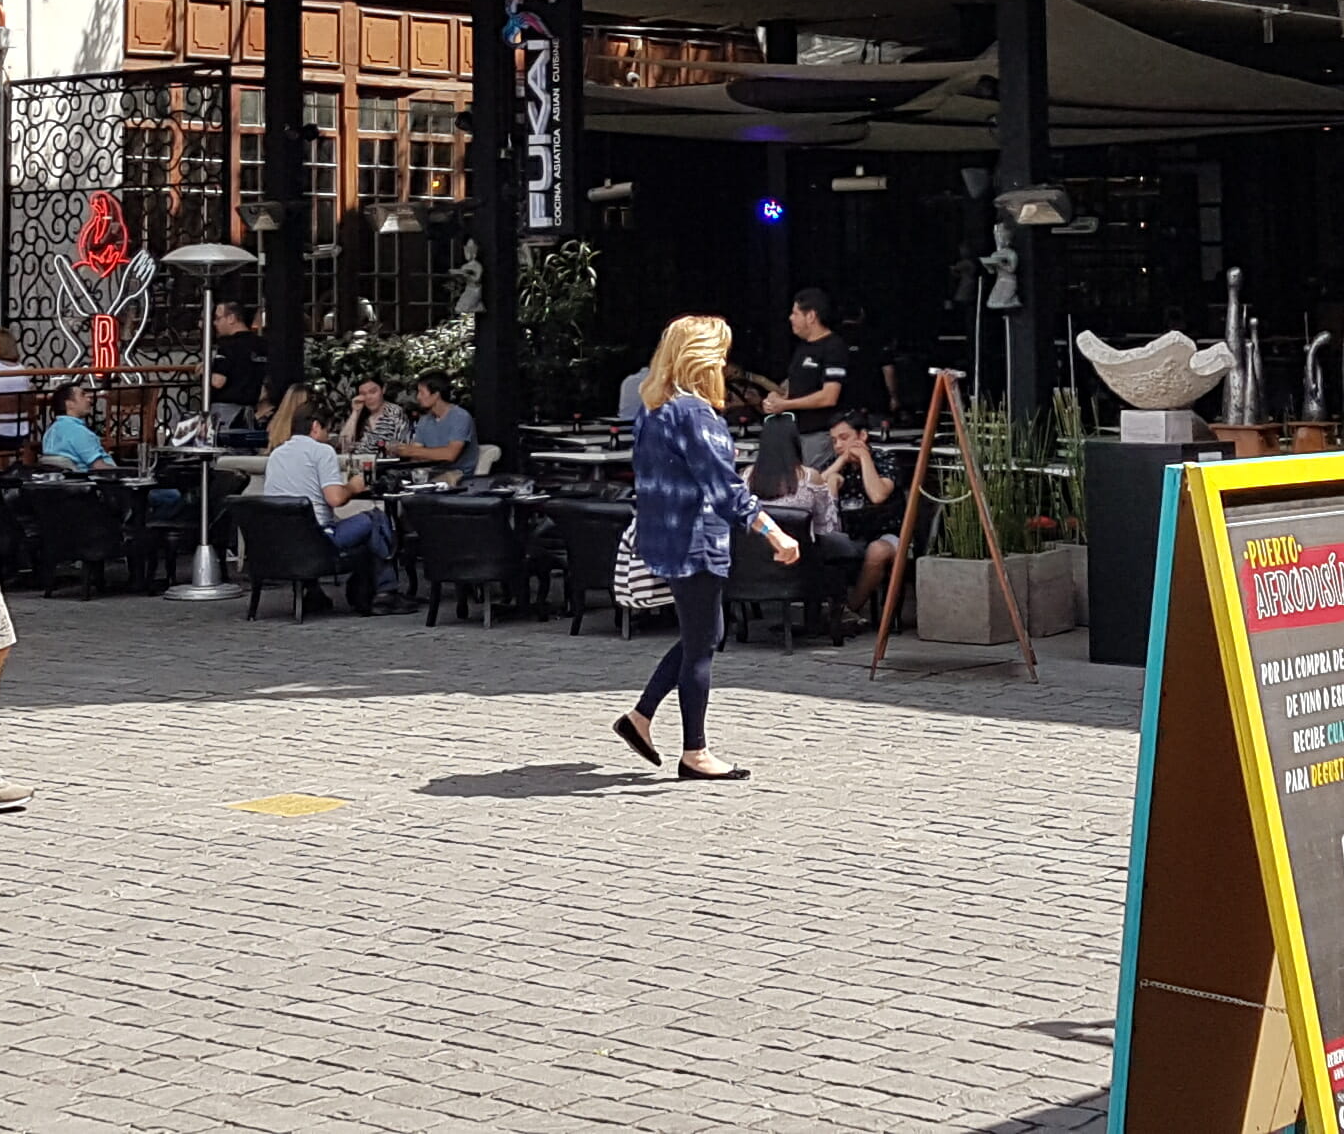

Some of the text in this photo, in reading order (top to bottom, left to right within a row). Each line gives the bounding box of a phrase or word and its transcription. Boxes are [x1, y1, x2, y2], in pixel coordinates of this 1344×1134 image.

[552, 88, 561, 122] ASIAN
[527, 39, 554, 227] FUKAI
[553, 128, 561, 179] ASIATICA
[554, 182, 562, 227] COCINA
[1261, 661, 1281, 685] POR
[1281, 658, 1294, 681] LA
[1295, 651, 1332, 678] COMPRA
[1332, 648, 1344, 671] DE
[1286, 695, 1299, 718] DE
[1300, 690, 1322, 715] VINO
[1323, 687, 1330, 710] O
[1293, 726, 1326, 753] RECIBE
[1285, 766, 1310, 794] PARA
